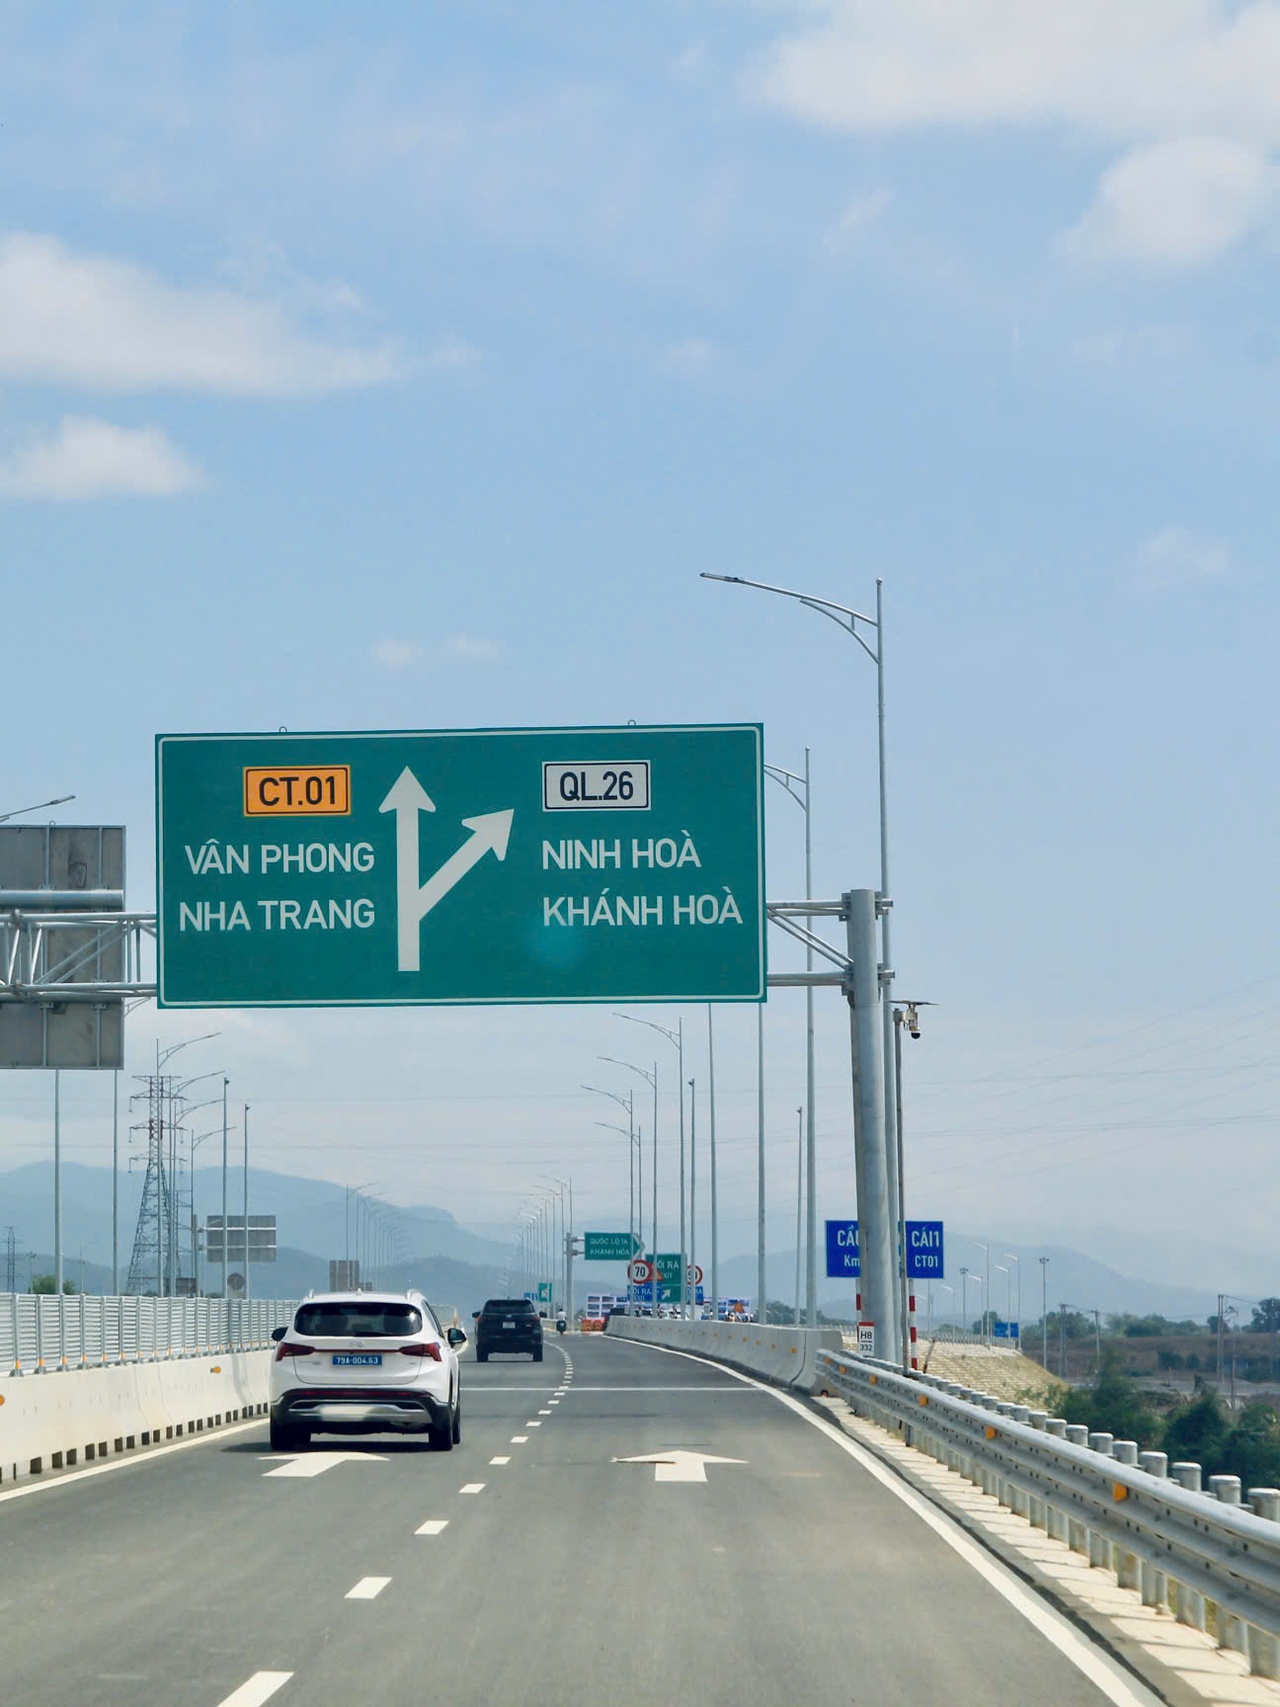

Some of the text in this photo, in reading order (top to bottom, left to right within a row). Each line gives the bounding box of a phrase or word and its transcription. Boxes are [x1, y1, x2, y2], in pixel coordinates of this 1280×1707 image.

[258, 774, 337, 807] CT.01
[559, 771, 634, 802] QL.26
[184, 838, 375, 875] VÂN PHONG
[542, 829, 702, 870] NINH HOÀ
[179, 898, 375, 932] NHA TRANG
[543, 886, 743, 927] KHÁNH HOÀ
[635, 1266, 646, 1277] 70
[914, 1255, 938, 1268] CT01
[860, 1331, 872, 1340] H8
